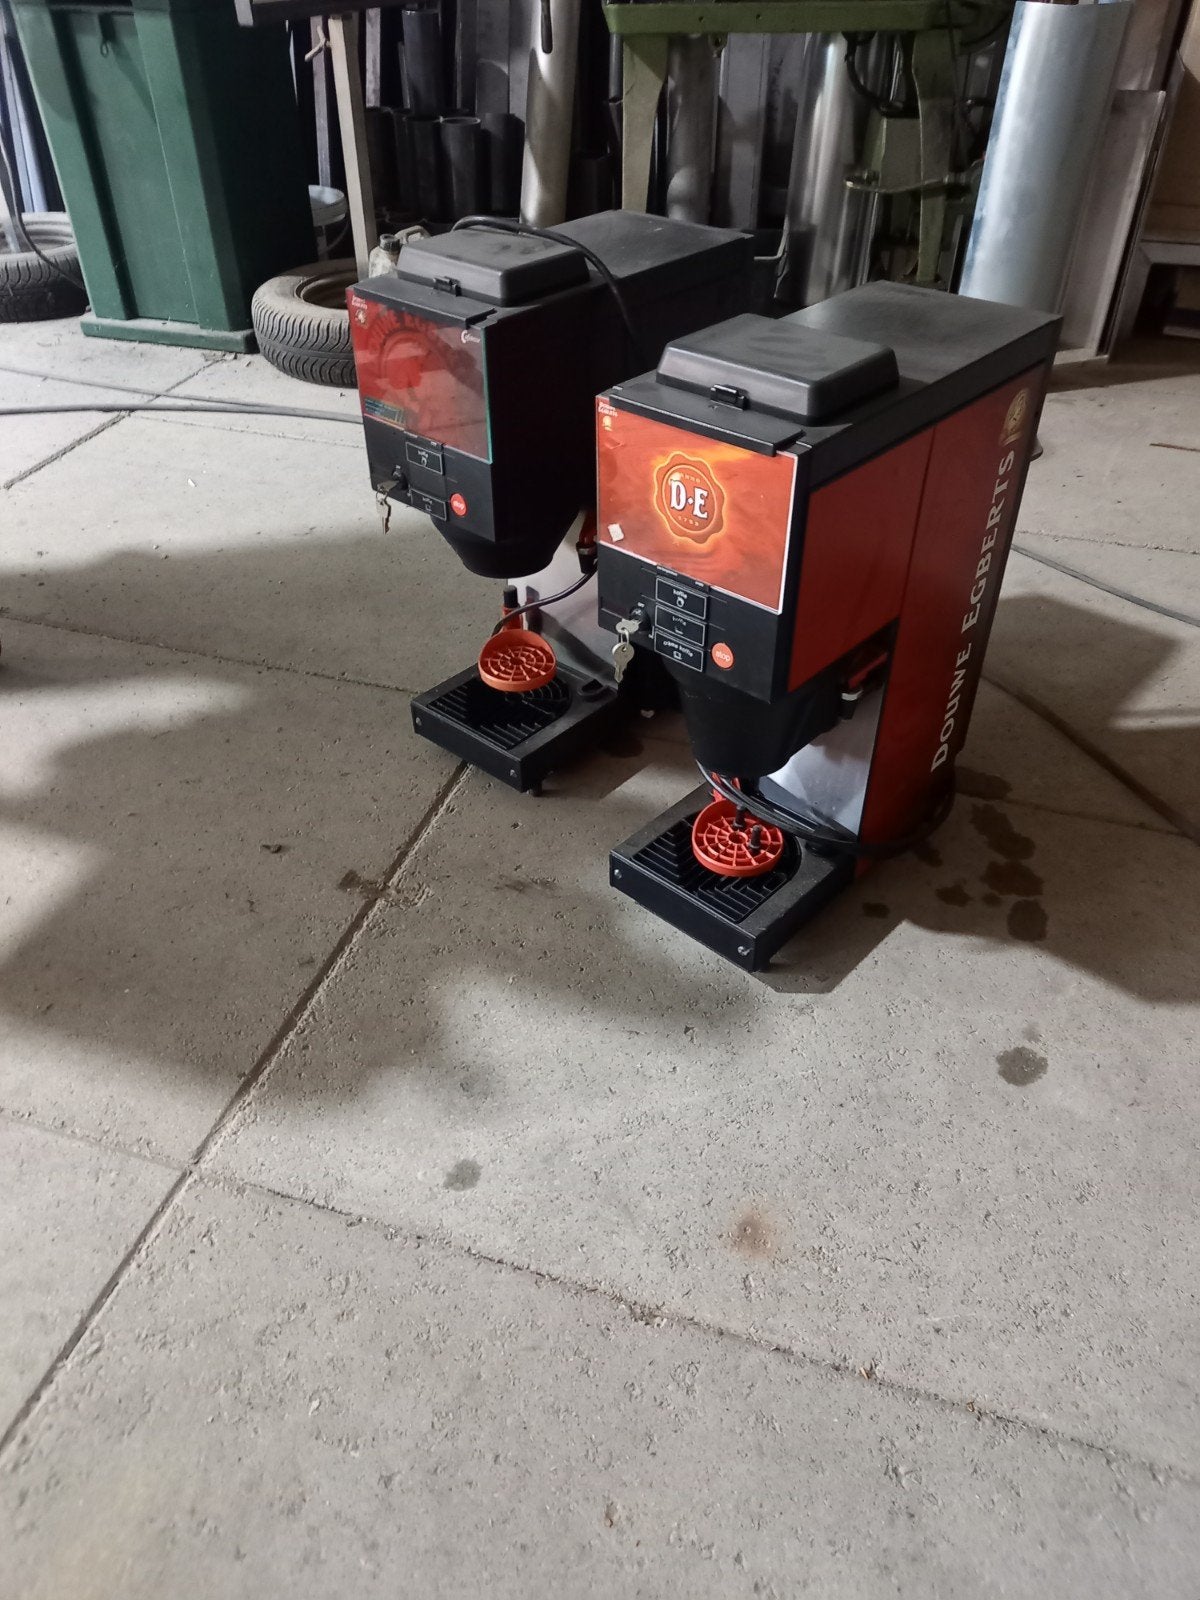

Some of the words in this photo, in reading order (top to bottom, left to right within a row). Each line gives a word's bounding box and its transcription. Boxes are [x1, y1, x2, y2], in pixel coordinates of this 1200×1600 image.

[715, 651, 731, 662] stop
[931, 643, 972, 772] DOUWE
[961, 450, 1015, 634] EGBERTS
